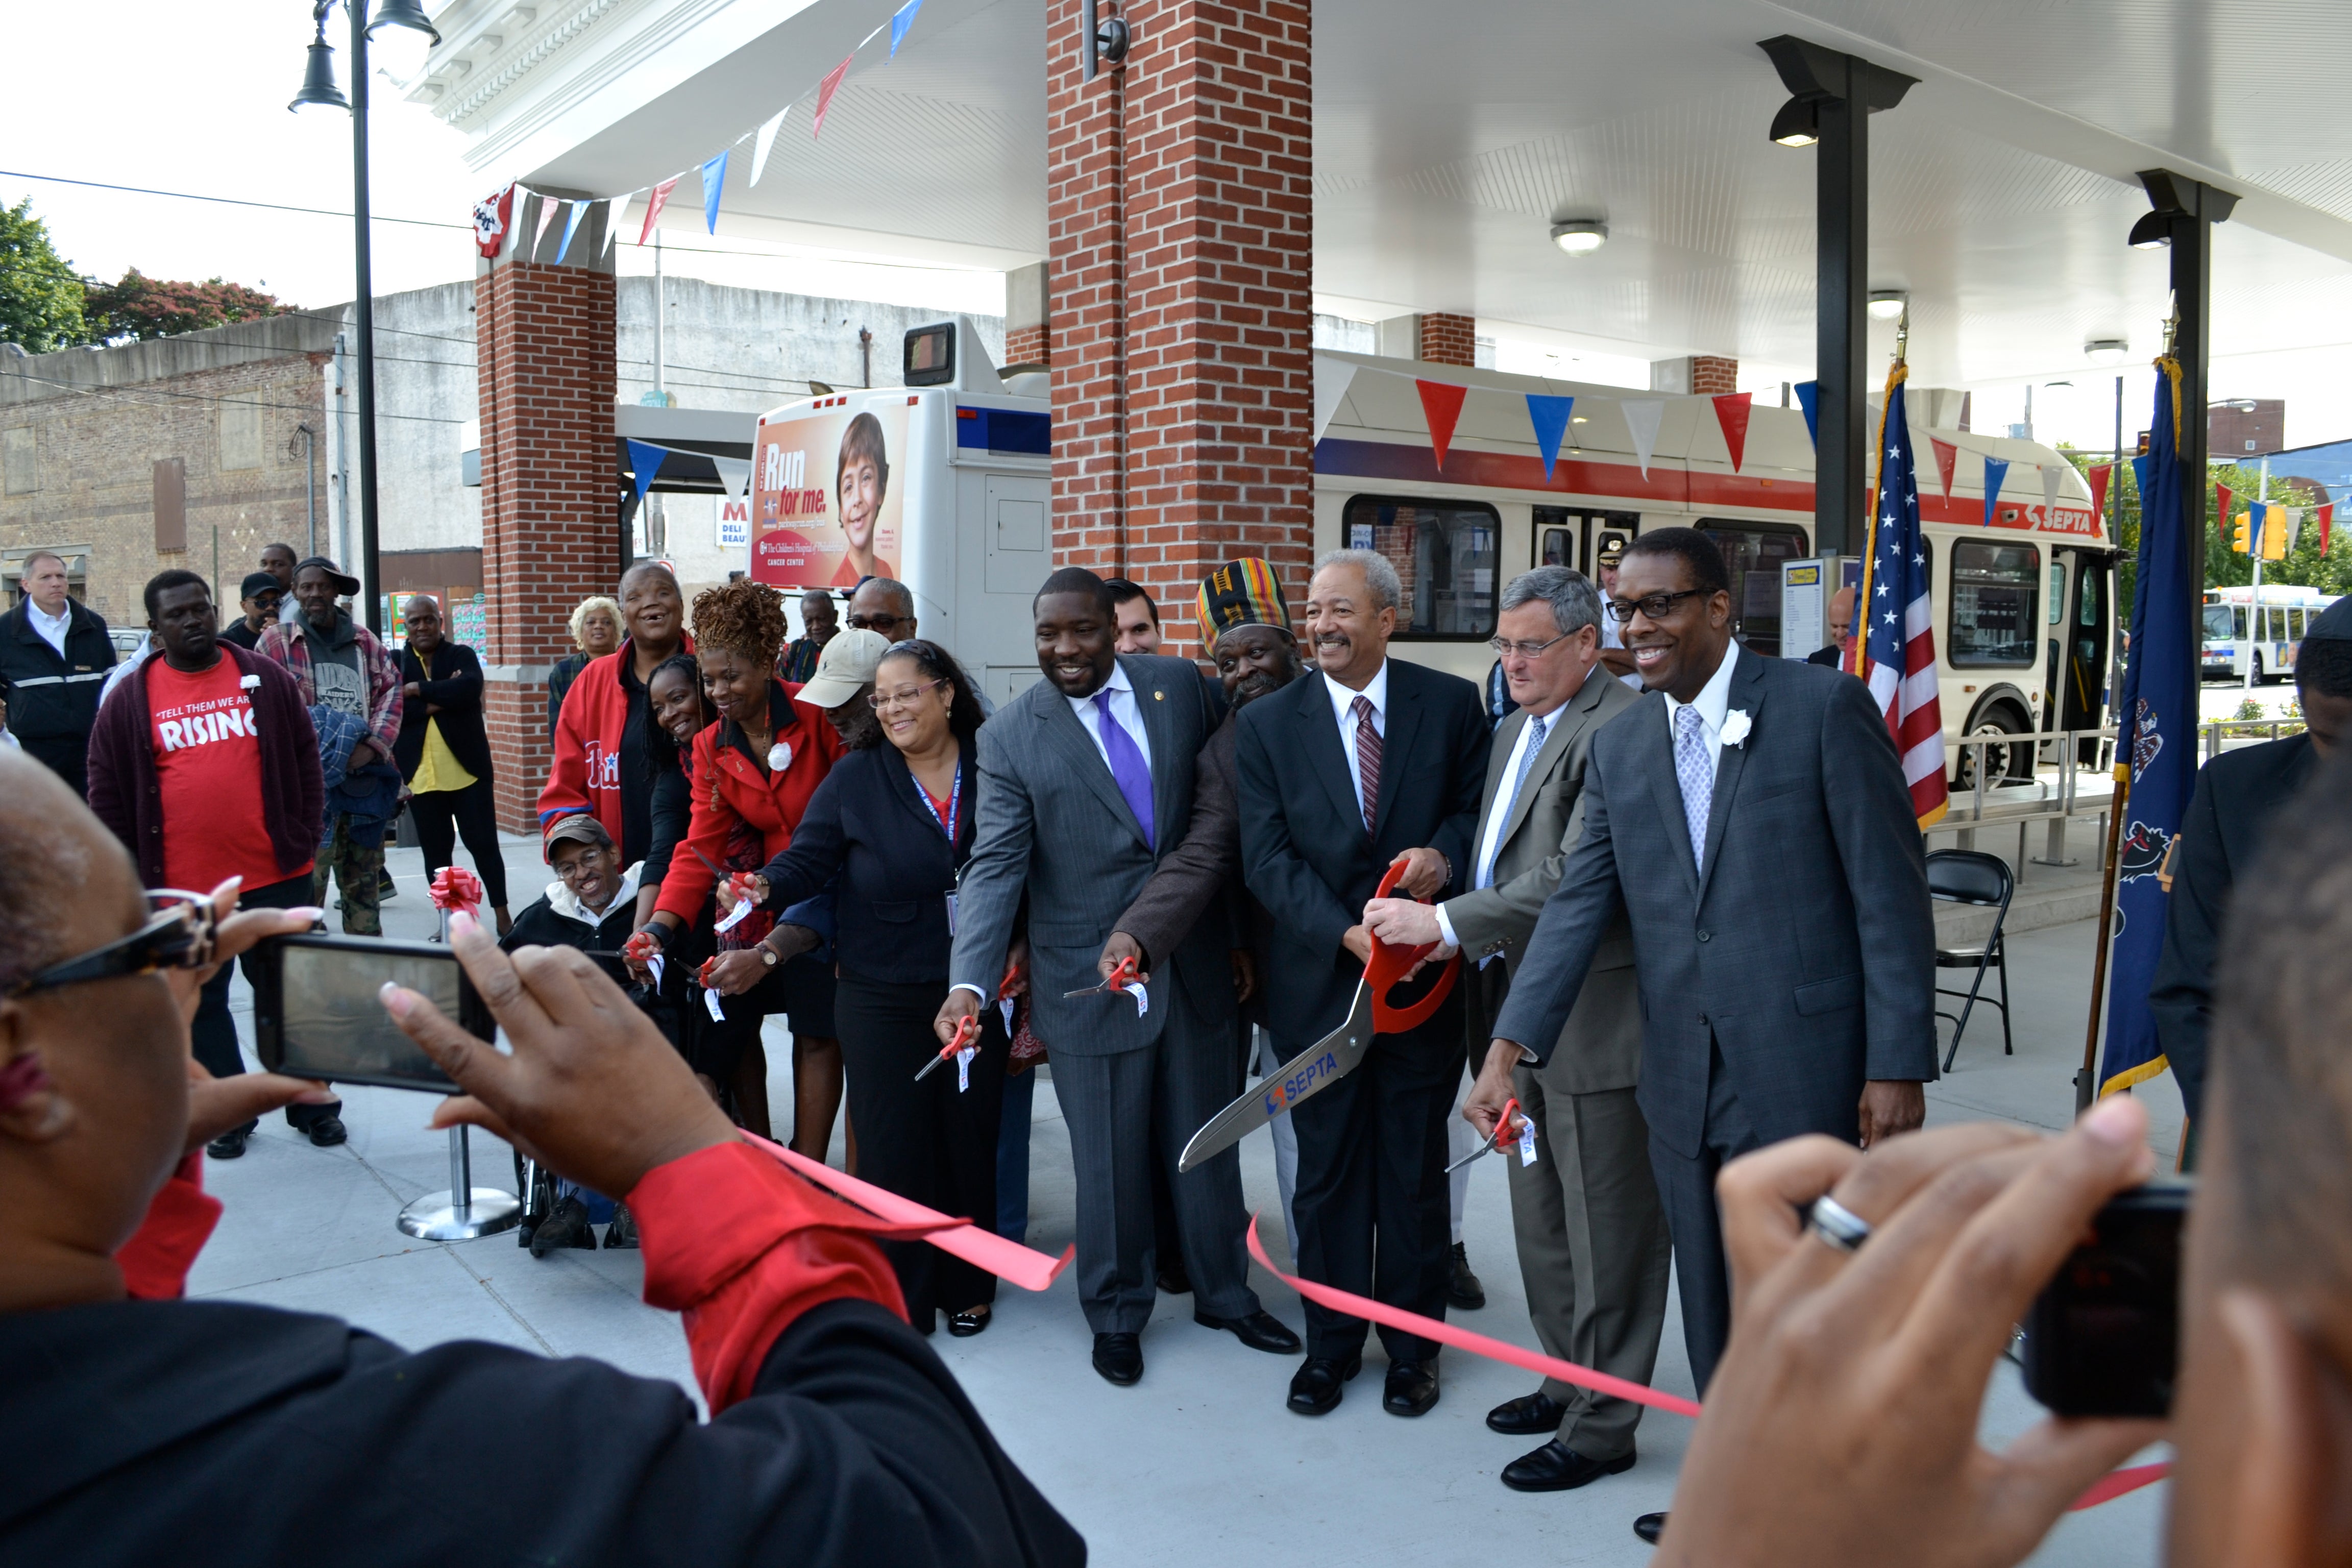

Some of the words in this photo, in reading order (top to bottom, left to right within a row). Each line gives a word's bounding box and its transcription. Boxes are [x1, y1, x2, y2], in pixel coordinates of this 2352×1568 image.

[765, 443, 805, 491] Run
[780, 485, 799, 514] for
[802, 488, 826, 513] me.
[2043, 510, 2090, 532] SEPTA
[185, 700, 215, 714] THEM
[217, 697, 234, 707] WE
[924, 798, 935, 812] SEPTA
[1284, 1051, 1337, 1102] SEPTA
